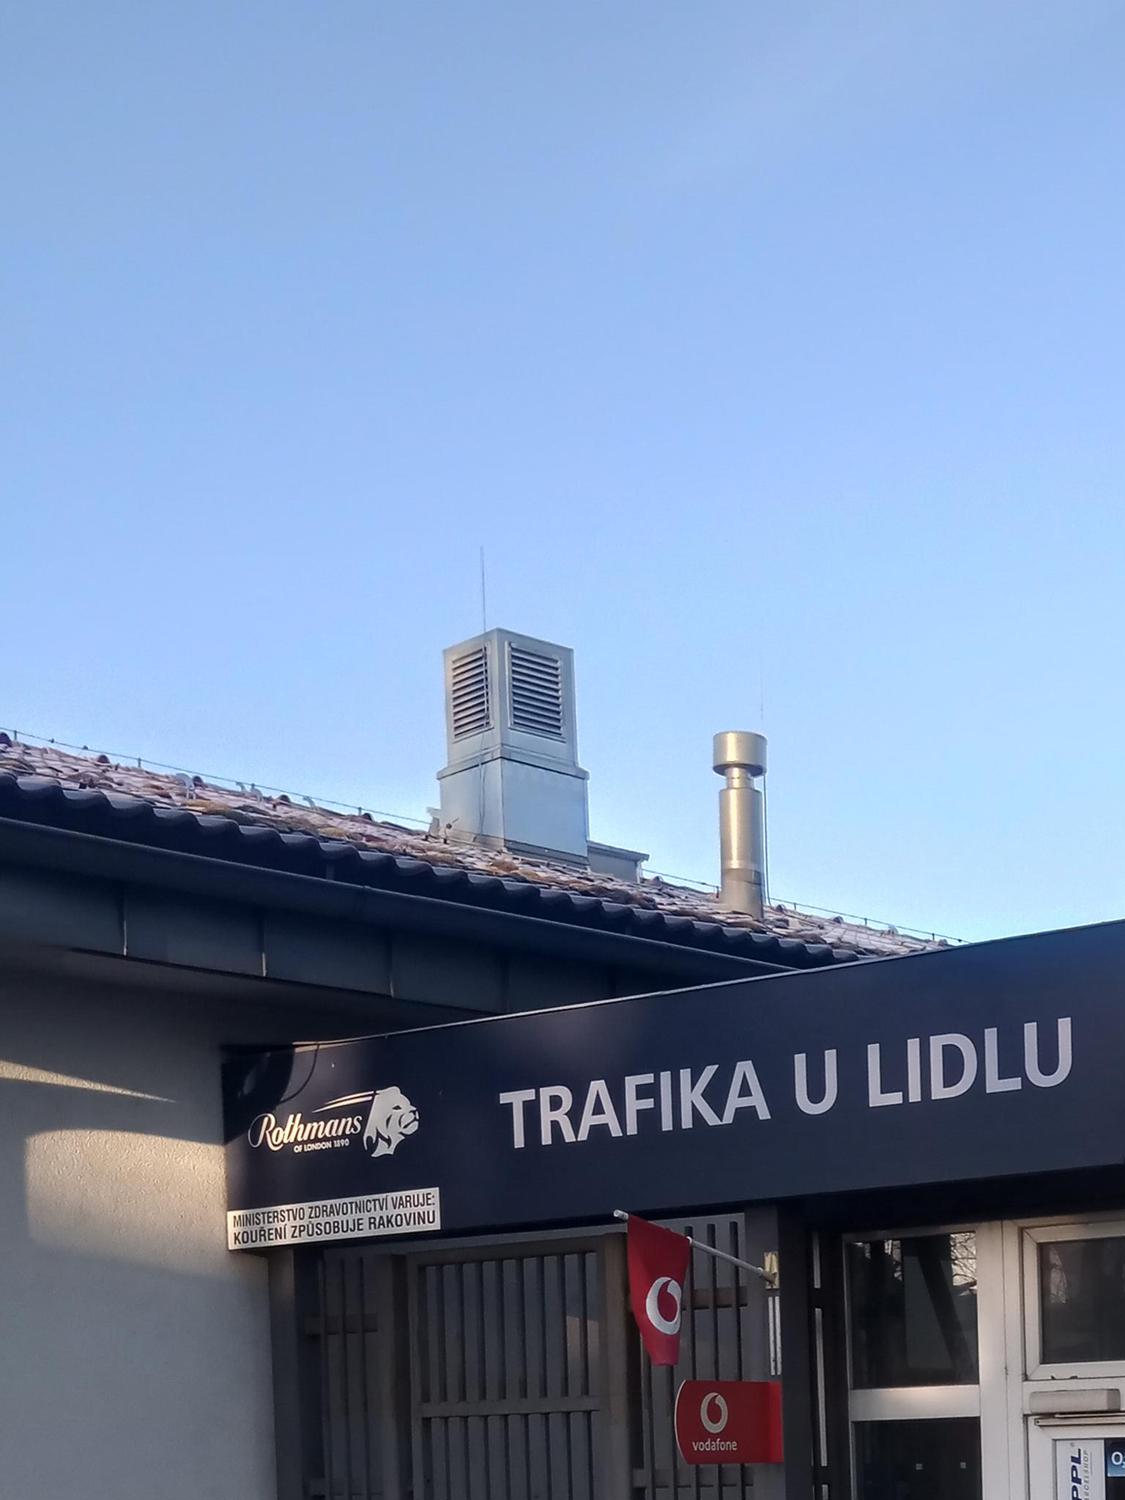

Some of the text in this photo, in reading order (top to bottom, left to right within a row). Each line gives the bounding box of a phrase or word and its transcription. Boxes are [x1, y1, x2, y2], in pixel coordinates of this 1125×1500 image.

[499, 1017, 1073, 1149] TRAFIKA U LIDLU
[247, 1112, 362, 1151] Rothmans
[293, 1138, 350, 1153] OF LONDON 1890
[233, 1192, 436, 1228] MINISTERSTVO ZDRAVOTNICTVÍ VARUJE:
[233, 1210, 436, 1245] KOUŘENÍ ZPŮSOBUJE RAKOVINU
[692, 1437, 738, 1452] vodafone
